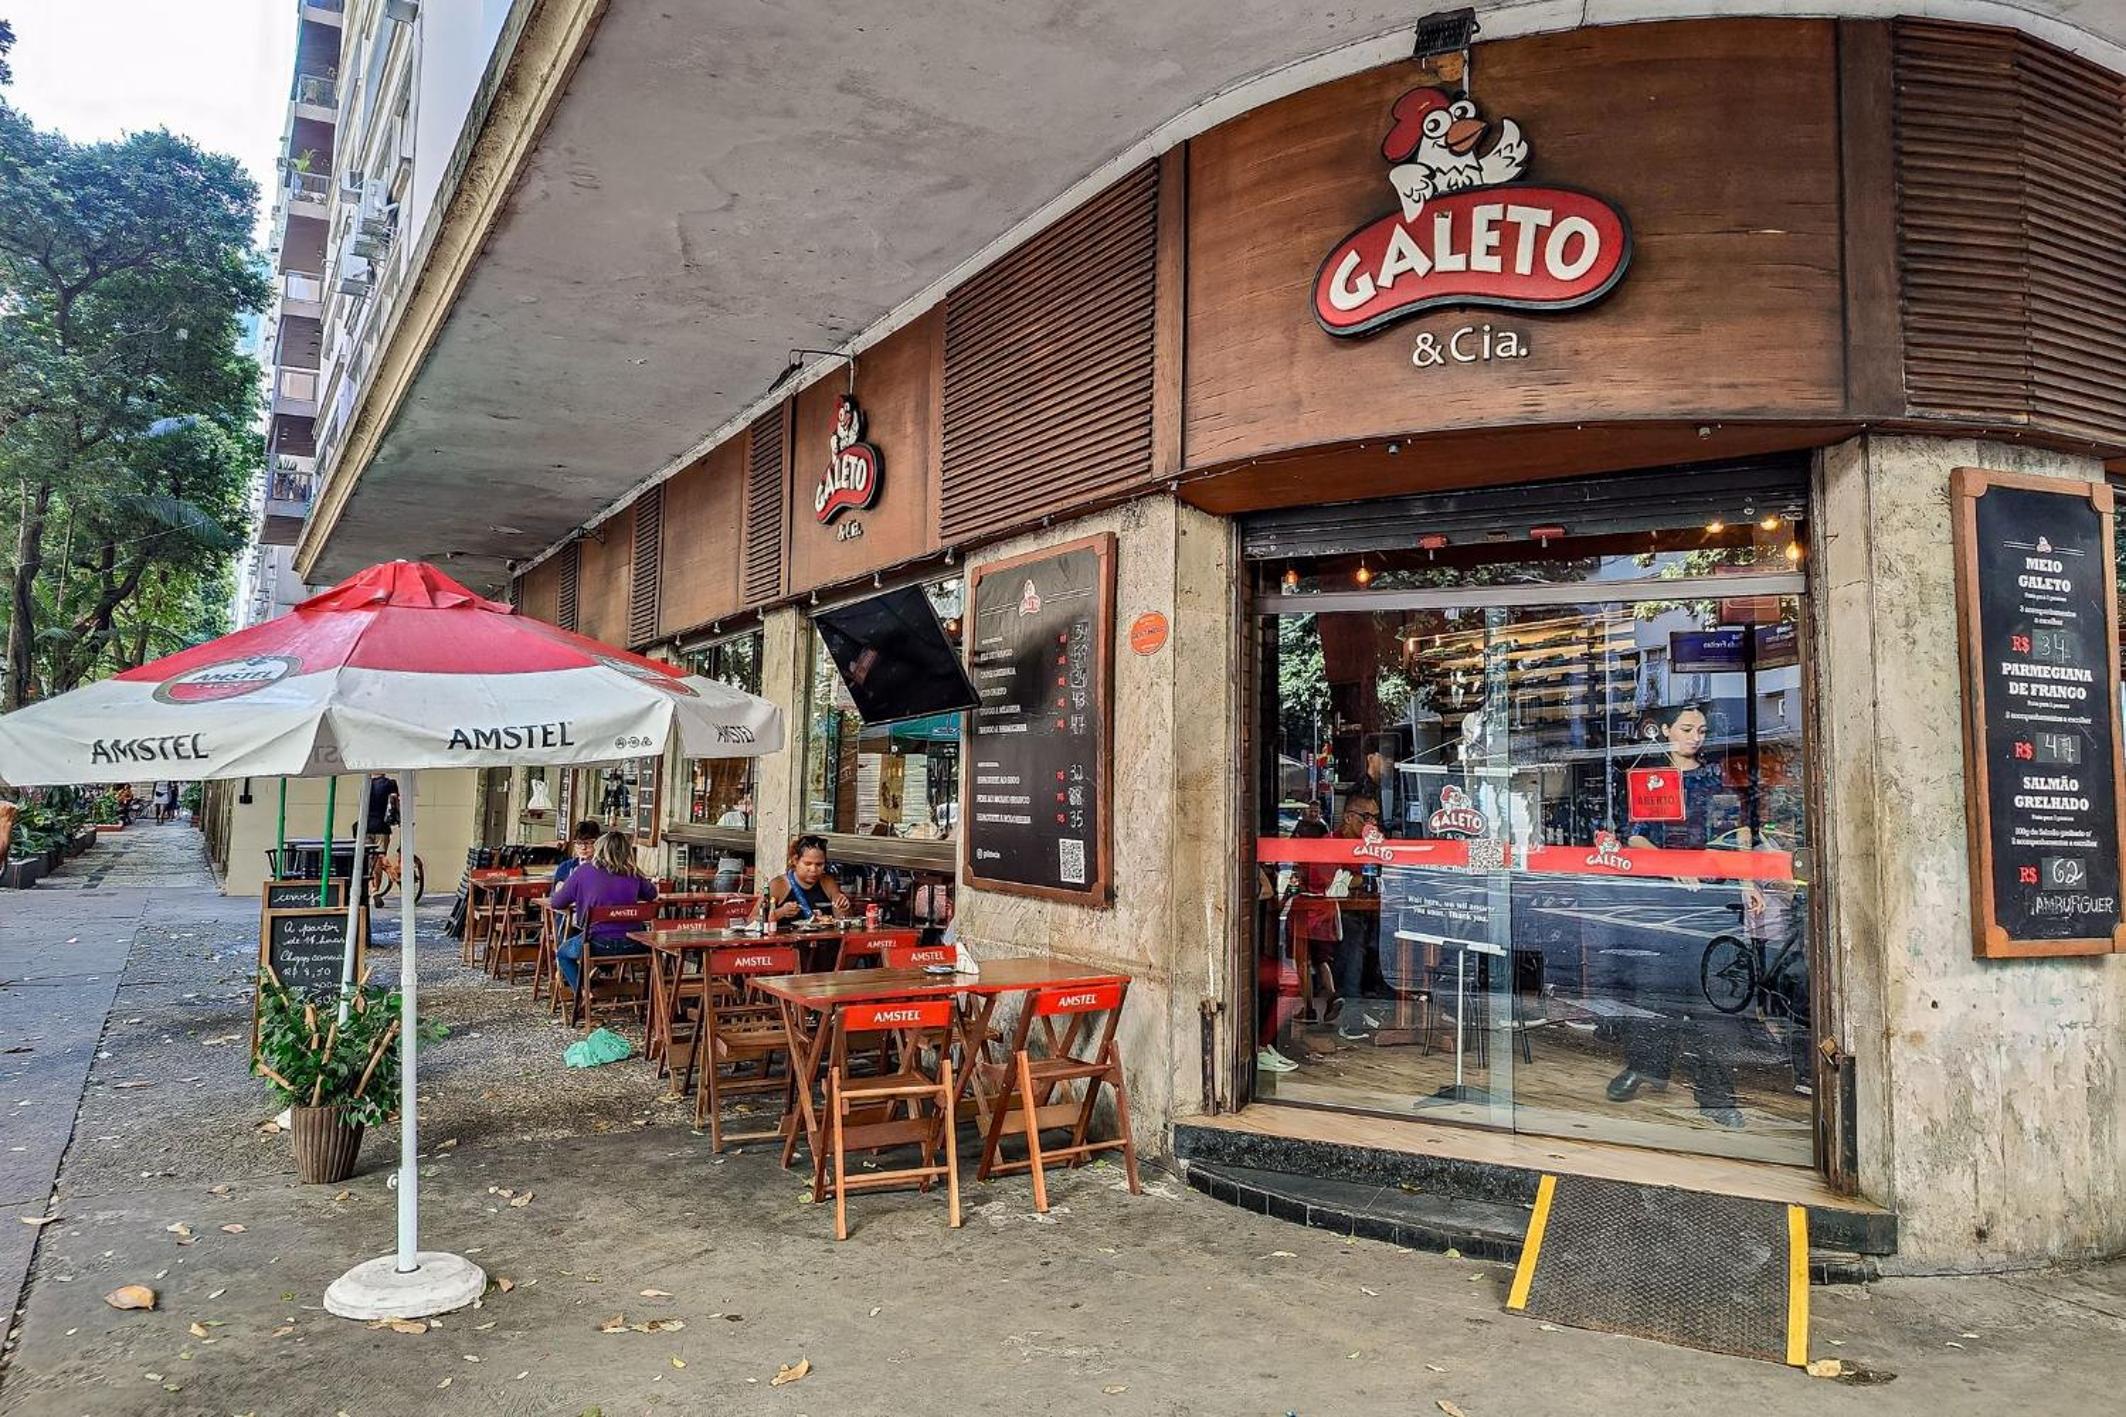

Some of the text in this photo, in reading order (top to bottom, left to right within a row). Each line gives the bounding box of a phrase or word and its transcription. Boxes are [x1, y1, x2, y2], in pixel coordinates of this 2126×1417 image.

[1328, 203, 1601, 312] GALETO
[1411, 323, 1530, 368] & Cia.
[814, 453, 868, 513] GALETO
[2025, 556, 2063, 573] MEIO
[2017, 574, 2072, 593] GALETO
[2011, 635, 2031, 655] R$
[2001, 662, 2094, 683] PARMEGIANA
[2008, 681, 2087, 700] DE FRANGO
[448, 721, 575, 750] AMSTEL
[90, 732, 210, 764] AMSTEL
[2014, 742, 2033, 761] R$
[2022, 775, 2080, 792] SALMÃO
[2013, 795, 2090, 812] GRELHADO
[1430, 812, 1482, 829] GALETO
[1353, 845, 1393, 861] GALETO
[1585, 853, 1633, 871] GALETO
[2019, 858, 2084, 885] R$ 62
[609, 908, 638, 918] AMSTEL
[299, 921, 340, 937] partir
[866, 940, 897, 949] AMSTEL
[734, 956, 773, 967] AMSTEL
[911, 951, 945, 962] AMSTEL
[1058, 994, 1097, 1007] AMSTEL
[873, 1010, 921, 1023] AMSTEL
